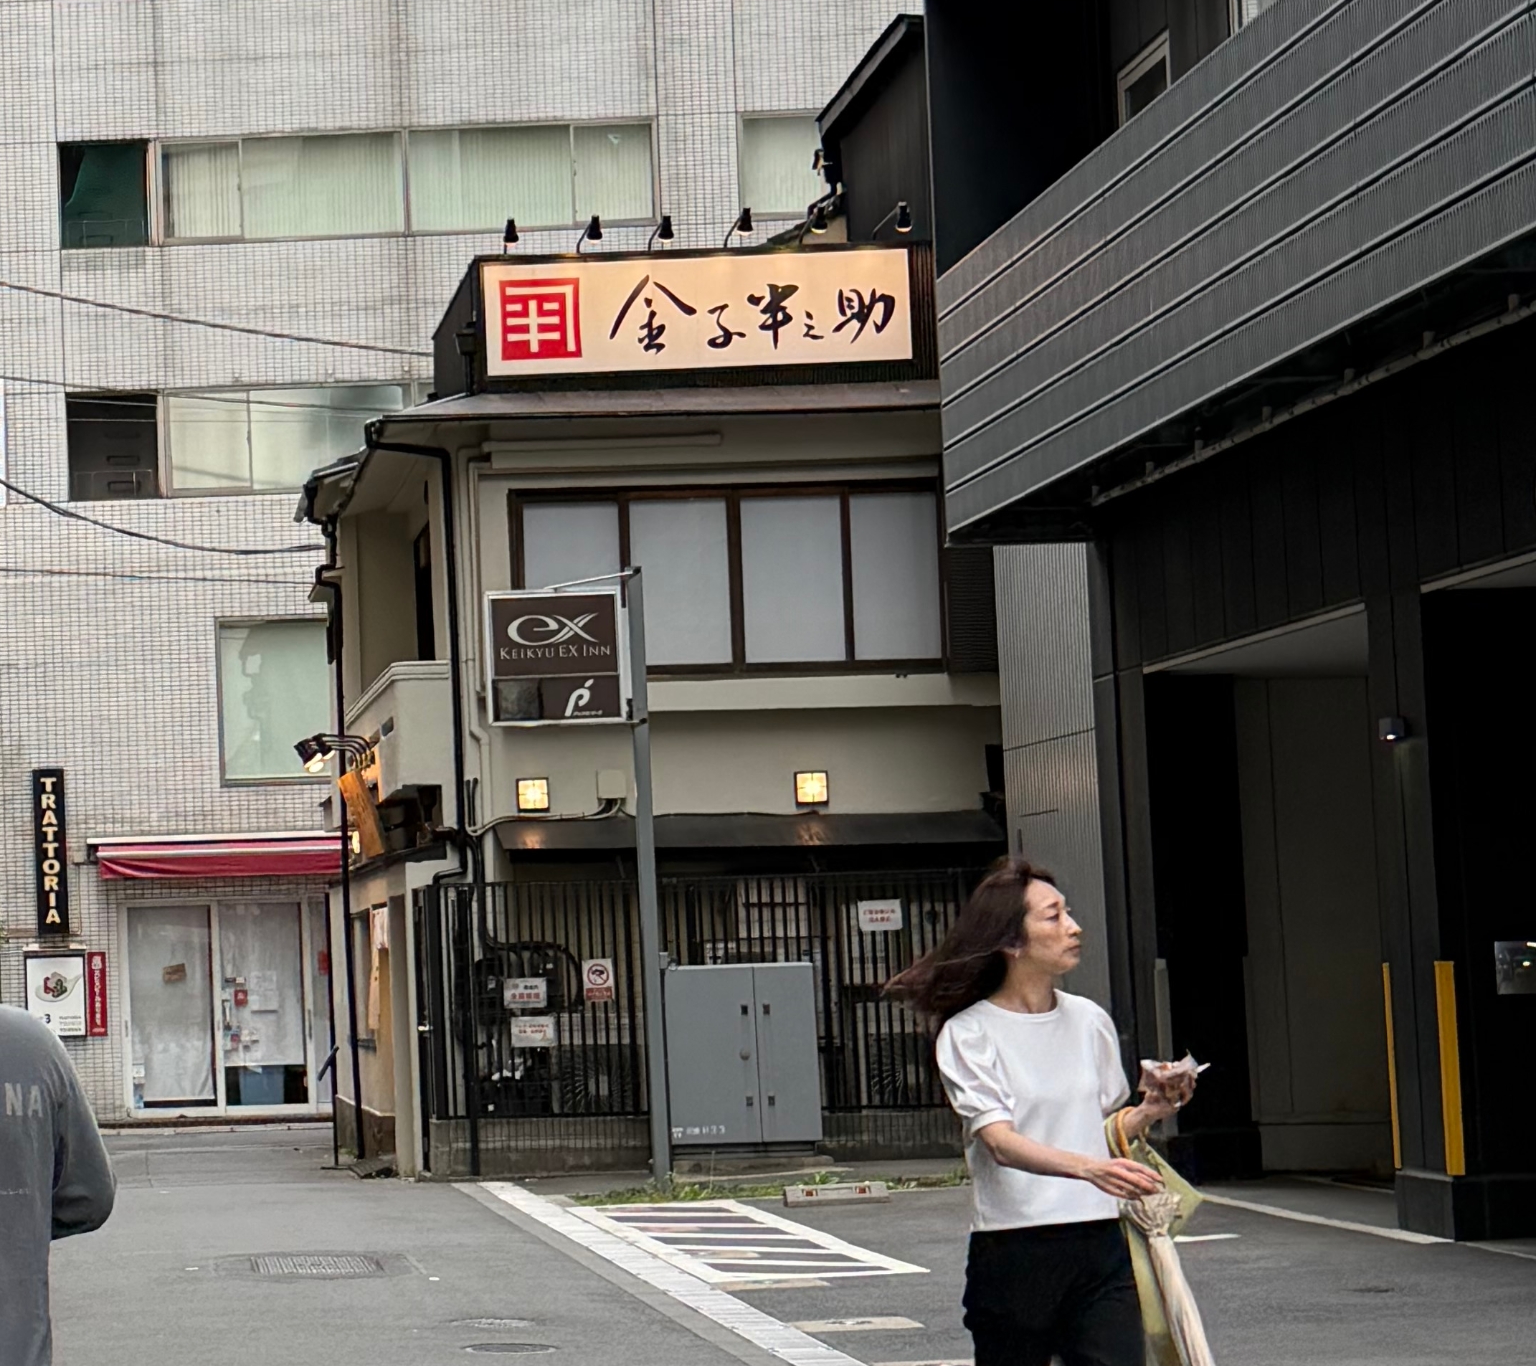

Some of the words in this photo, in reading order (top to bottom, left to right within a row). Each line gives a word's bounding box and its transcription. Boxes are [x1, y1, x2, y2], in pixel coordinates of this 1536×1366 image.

[610, 273, 896, 355] 金子半之助
[500, 647, 555, 660] KEIKYU
[559, 645, 578, 657] EX
[583, 644, 611, 657] INN
[40, 777, 62, 924] TRATTORIA
